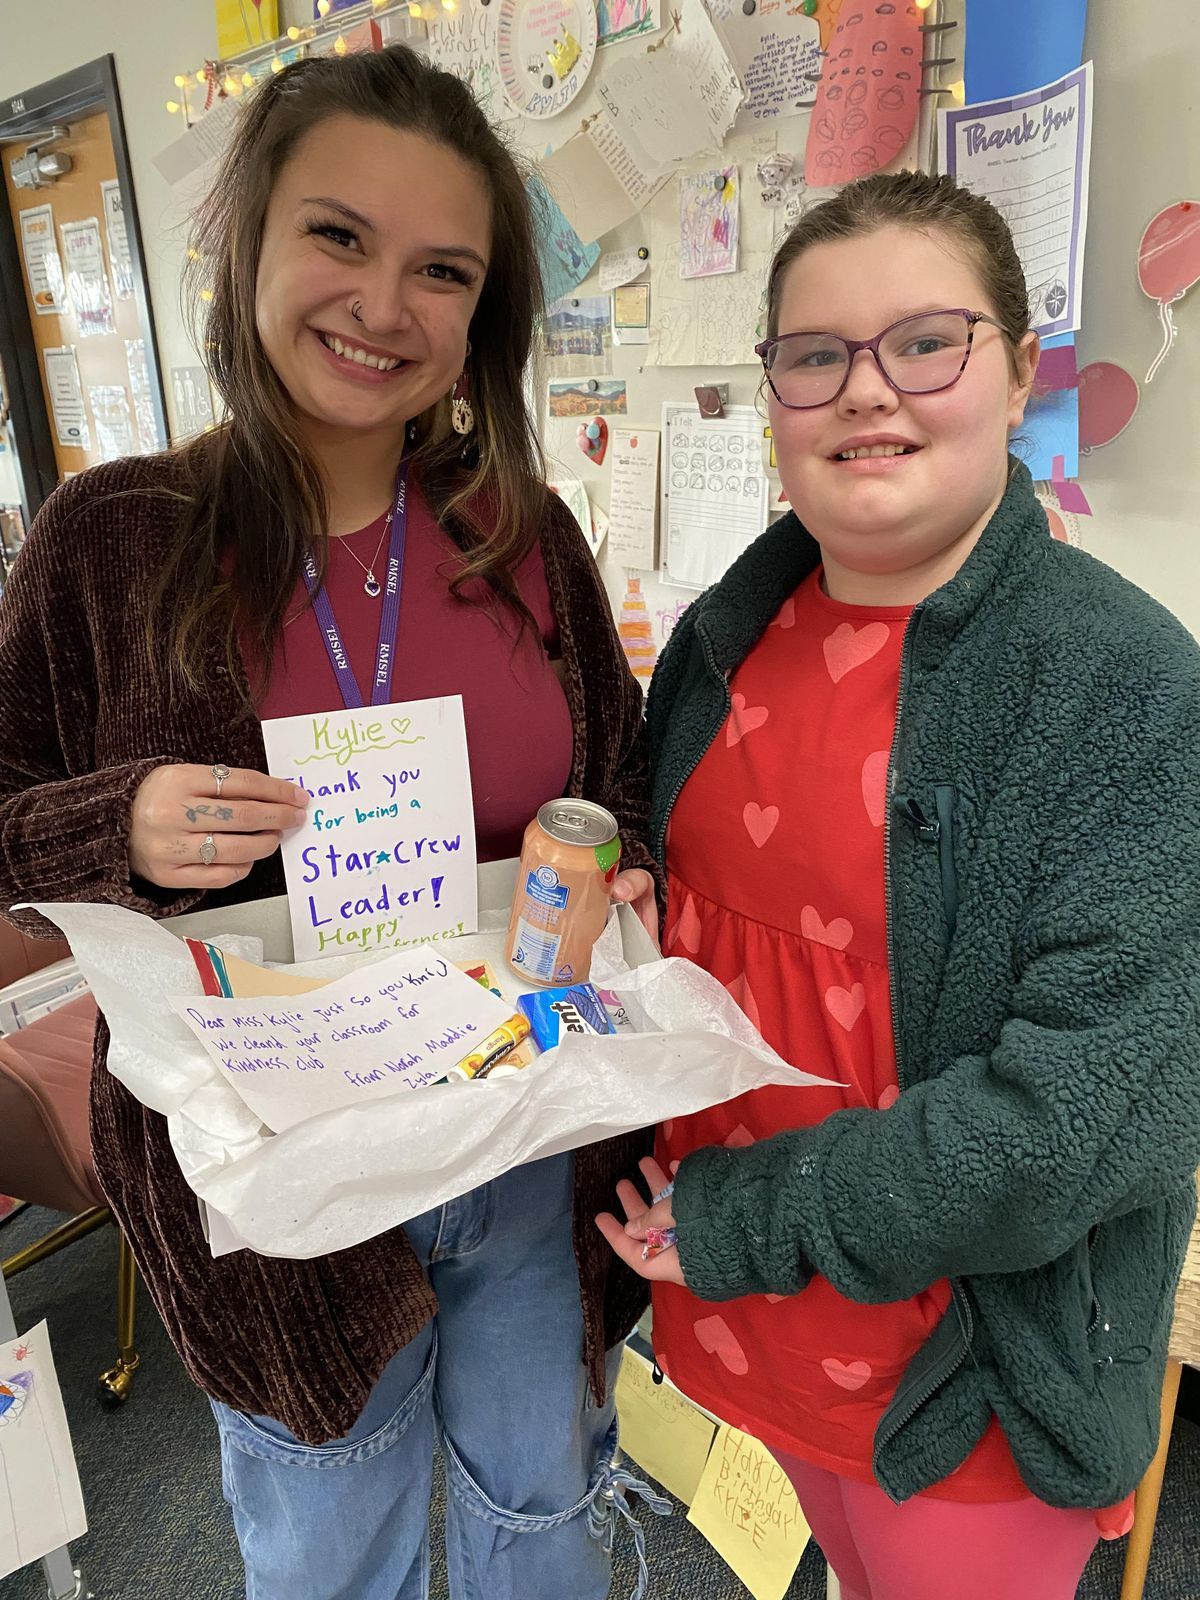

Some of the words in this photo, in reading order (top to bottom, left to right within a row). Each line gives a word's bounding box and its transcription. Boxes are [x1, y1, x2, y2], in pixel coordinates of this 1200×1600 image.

[962, 112, 1041, 157] Thank
[1042, 104, 1076, 143] You
[387, 558, 398, 596] RMSEL
[326, 624, 348, 670] RMSEL
[376, 643, 390, 687] RMSEL
[312, 717, 386, 766] Kylie
[285, 769, 361, 798] hank
[383, 768, 421, 798] you
[313, 809, 345, 831] for
[355, 803, 399, 824] being
[410, 799, 421, 809] a
[302, 844, 377, 883] Star
[309, 876, 444, 927] Leader!
[318, 919, 398, 952] Happy
[186, 1008, 225, 1030] Dear
[263, 1011, 304, 1034] Kylie
[378, 980, 404, 1001] you
[296, 1032, 321, 1053] your
[332, 1018, 392, 1042] classroom
[397, 1003, 420, 1020] for
[425, 1023, 477, 1054] Maddie
